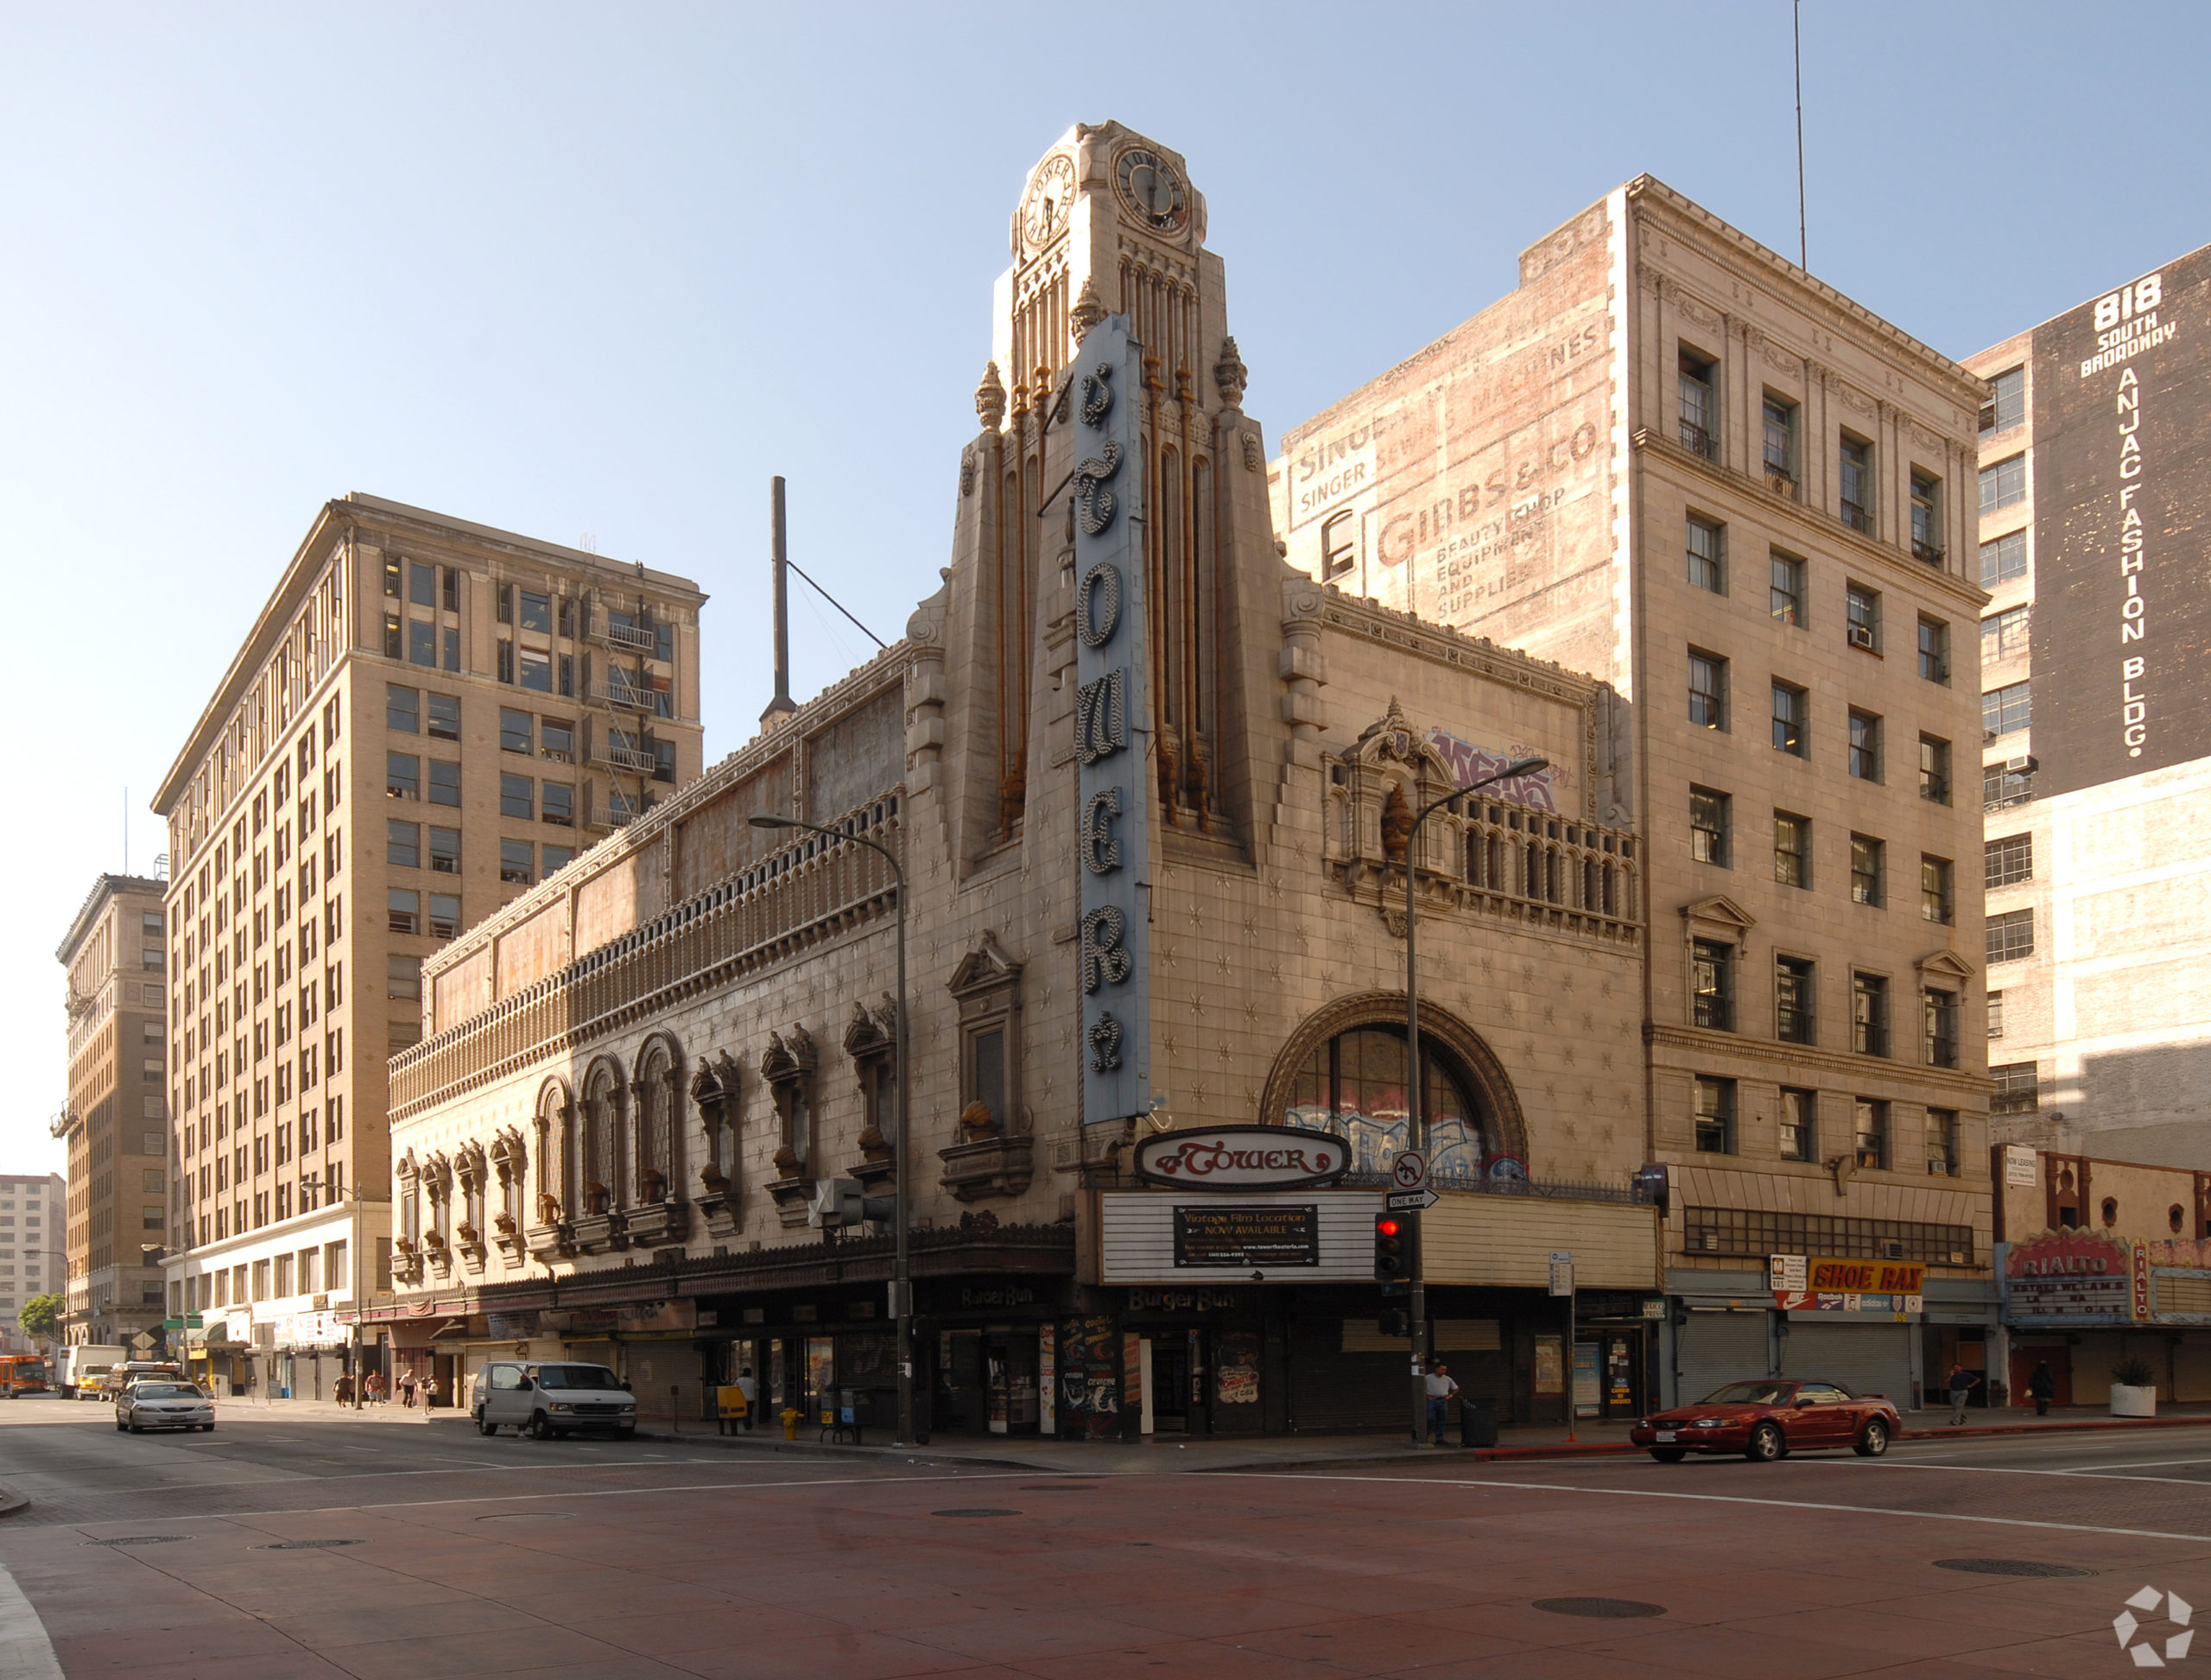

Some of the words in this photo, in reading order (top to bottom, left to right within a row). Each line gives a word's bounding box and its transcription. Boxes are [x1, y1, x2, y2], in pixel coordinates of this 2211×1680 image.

[2094, 275, 2162, 333] 818
[2080, 321, 2176, 378] BROADWAY
[2097, 311, 2157, 352] SOUTH
[2118, 366, 2142, 480] ANJAC
[1301, 461, 1366, 514] SINGER
[1378, 468, 1506, 567] GIBBS
[1436, 519, 1503, 564] BEAUTY
[1511, 487, 1566, 525] SHOP
[2119, 485, 2144, 644] FASHION
[1437, 574, 1473, 601] AND
[1156, 1140, 1332, 1175] TOWER
[1184, 1214, 1227, 1224] Vintage
[1256, 1214, 1306, 1222] Location
[1391, 1196, 1409, 1208] ONE
[1410, 1195, 1425, 1206] WAY
[1813, 1264, 1875, 1290] SHOE
[1879, 1266, 1924, 1290] RAX
[2022, 1257, 2108, 1275] RIALTO
[2136, 1248, 2148, 1315] RIALTO
[1005, 1285, 1034, 1306] Bun
[1129, 1288, 1195, 1311] Burger
[1197, 1288, 1234, 1311] Bun
[1861, 1298, 1883, 1307] adidas
